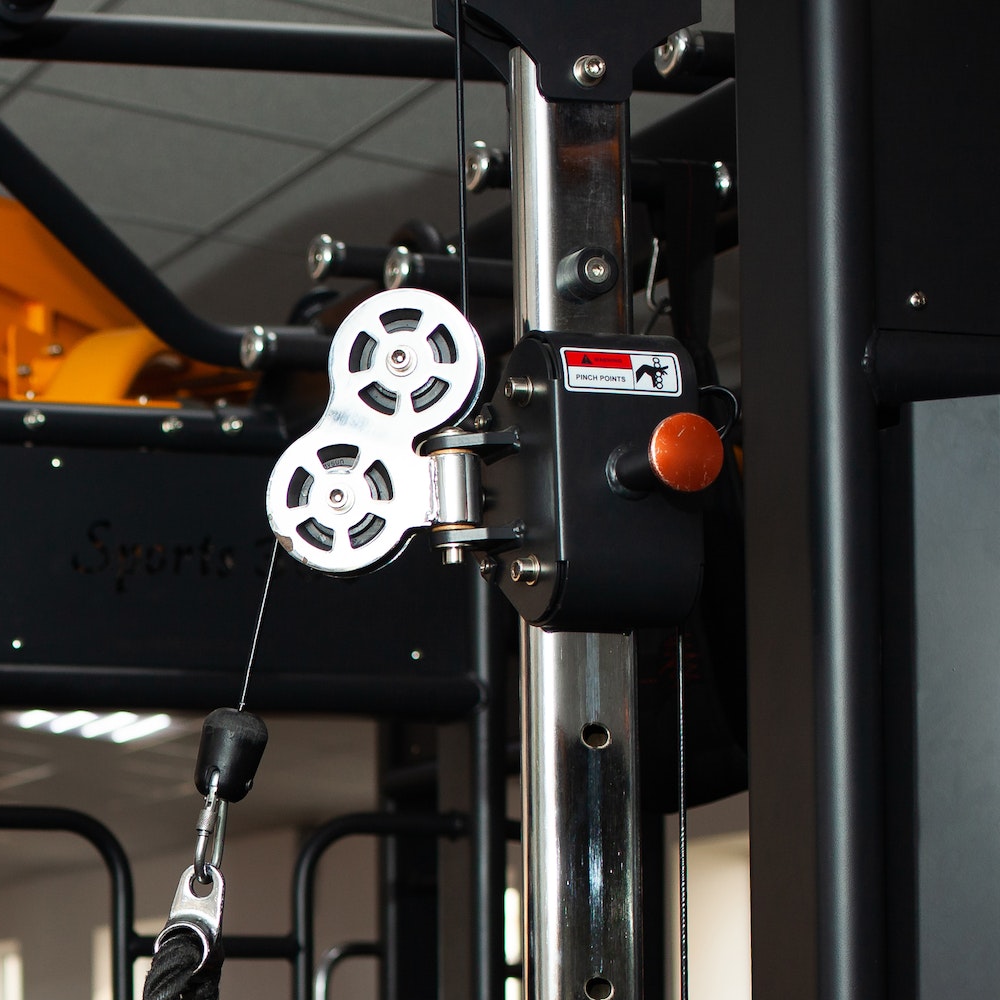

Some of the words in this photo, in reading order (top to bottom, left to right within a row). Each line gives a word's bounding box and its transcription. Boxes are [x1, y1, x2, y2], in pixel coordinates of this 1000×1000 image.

[575, 374, 598, 382] PINCH
[599, 375, 626, 383] POINTS
[71, 520, 235, 593] Sports
